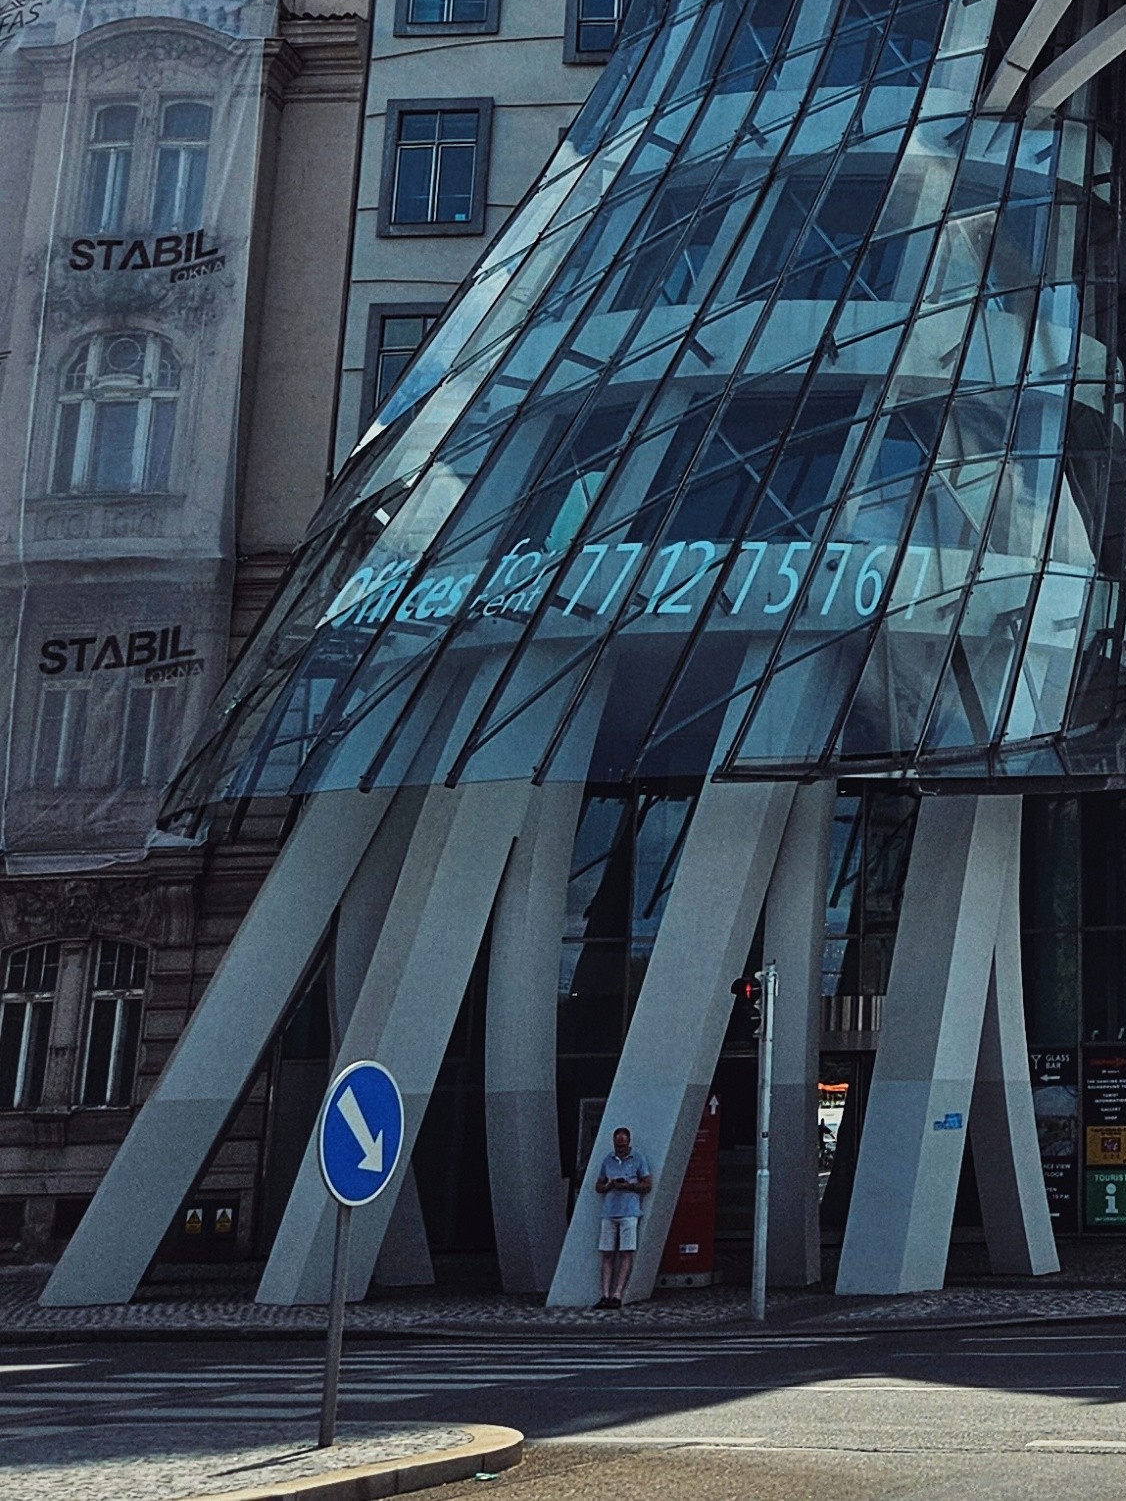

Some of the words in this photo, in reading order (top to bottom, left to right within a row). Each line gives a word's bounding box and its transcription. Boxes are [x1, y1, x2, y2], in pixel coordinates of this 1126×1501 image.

[68, 228, 219, 271] STABIL
[174, 259, 225, 282] OKNA
[38, 624, 196, 675] STABIL
[149, 662, 203, 683] OKNA
[1045, 1054, 1070, 1063] GLASS
[1045, 1062, 1062, 1070] BAR
